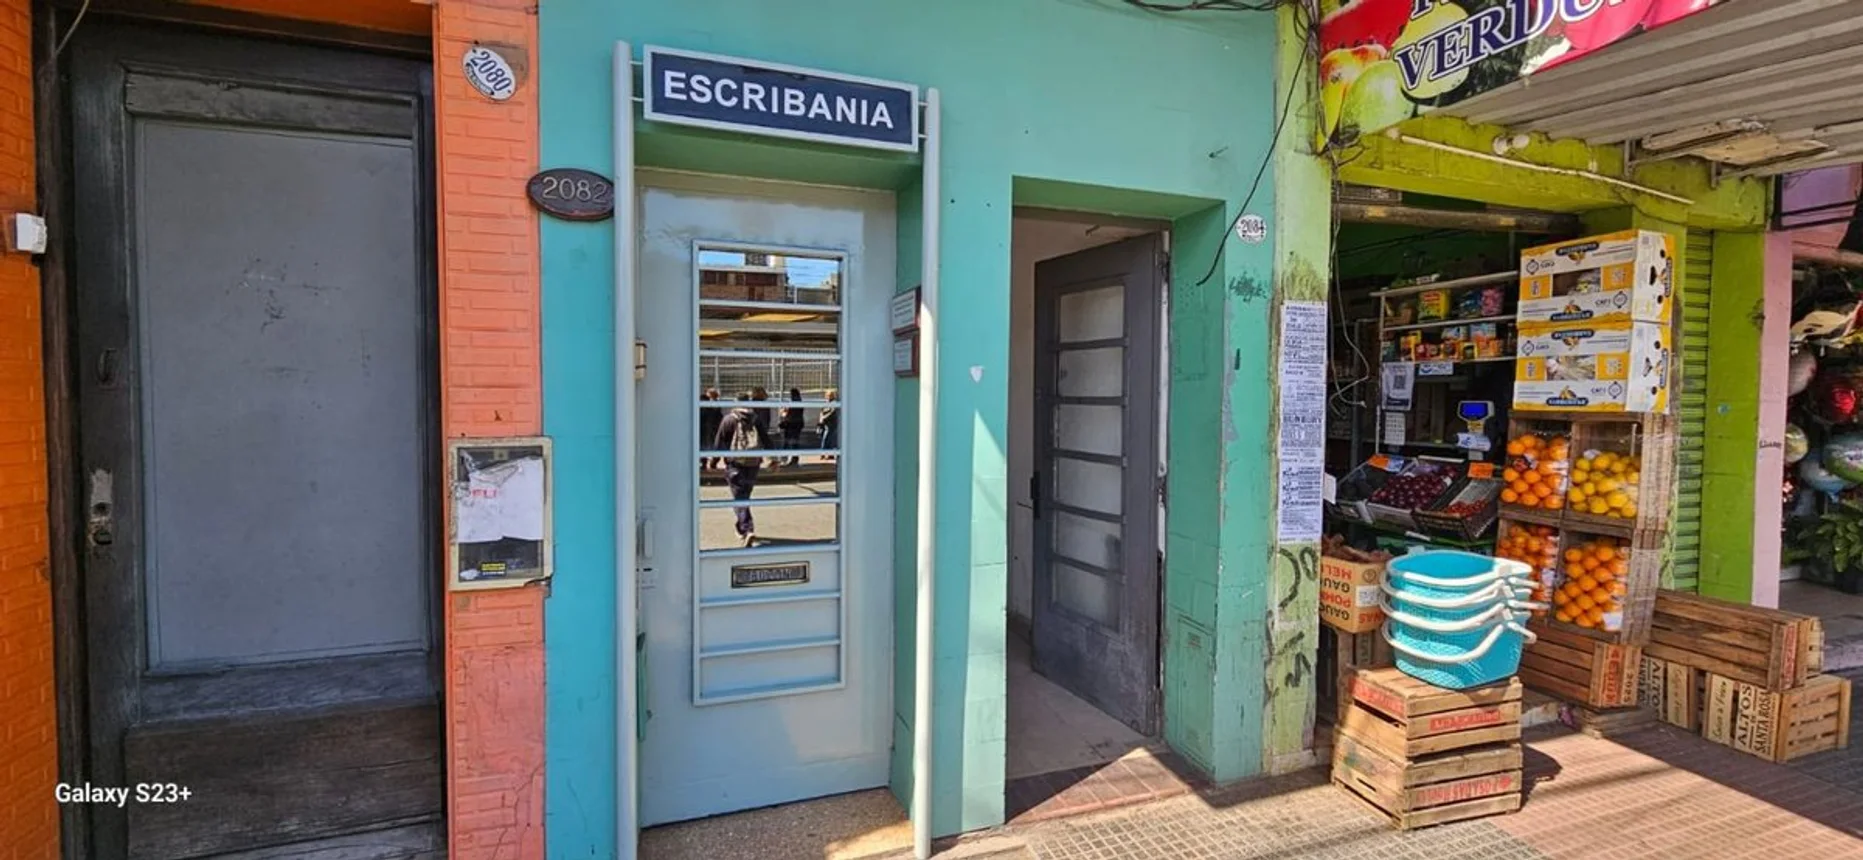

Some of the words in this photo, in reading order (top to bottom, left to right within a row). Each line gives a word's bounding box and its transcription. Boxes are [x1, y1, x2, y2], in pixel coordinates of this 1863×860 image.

[1394, 0, 1628, 90] VERDU
[470, 50, 512, 92] 2080
[663, 69, 894, 129] ESCRIBANIA
[542, 176, 607, 203] 2082
[1240, 219, 1265, 234] 2084
[1321, 563, 1352, 580] MEL
[1321, 577, 1350, 593] GAU
[1737, 685, 1752, 746] ALTOS
[1753, 717, 1768, 754] SANTA
